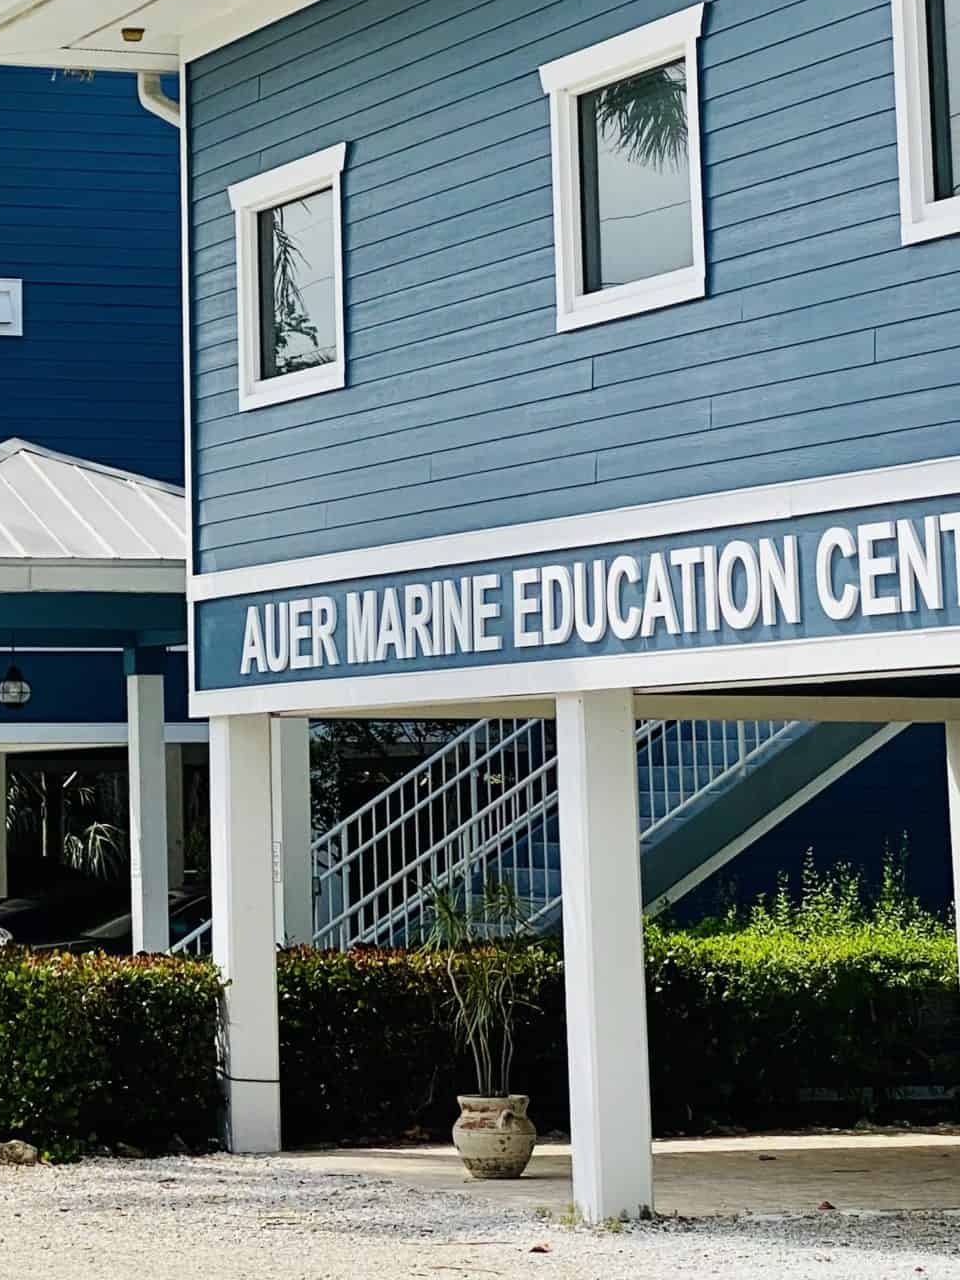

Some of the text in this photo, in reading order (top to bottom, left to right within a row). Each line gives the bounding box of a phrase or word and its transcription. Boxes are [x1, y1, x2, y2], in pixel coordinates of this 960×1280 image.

[240, 596, 340, 675] AUER
[346, 574, 502, 664] MARINE
[513, 535, 801, 644] EDUCATION
